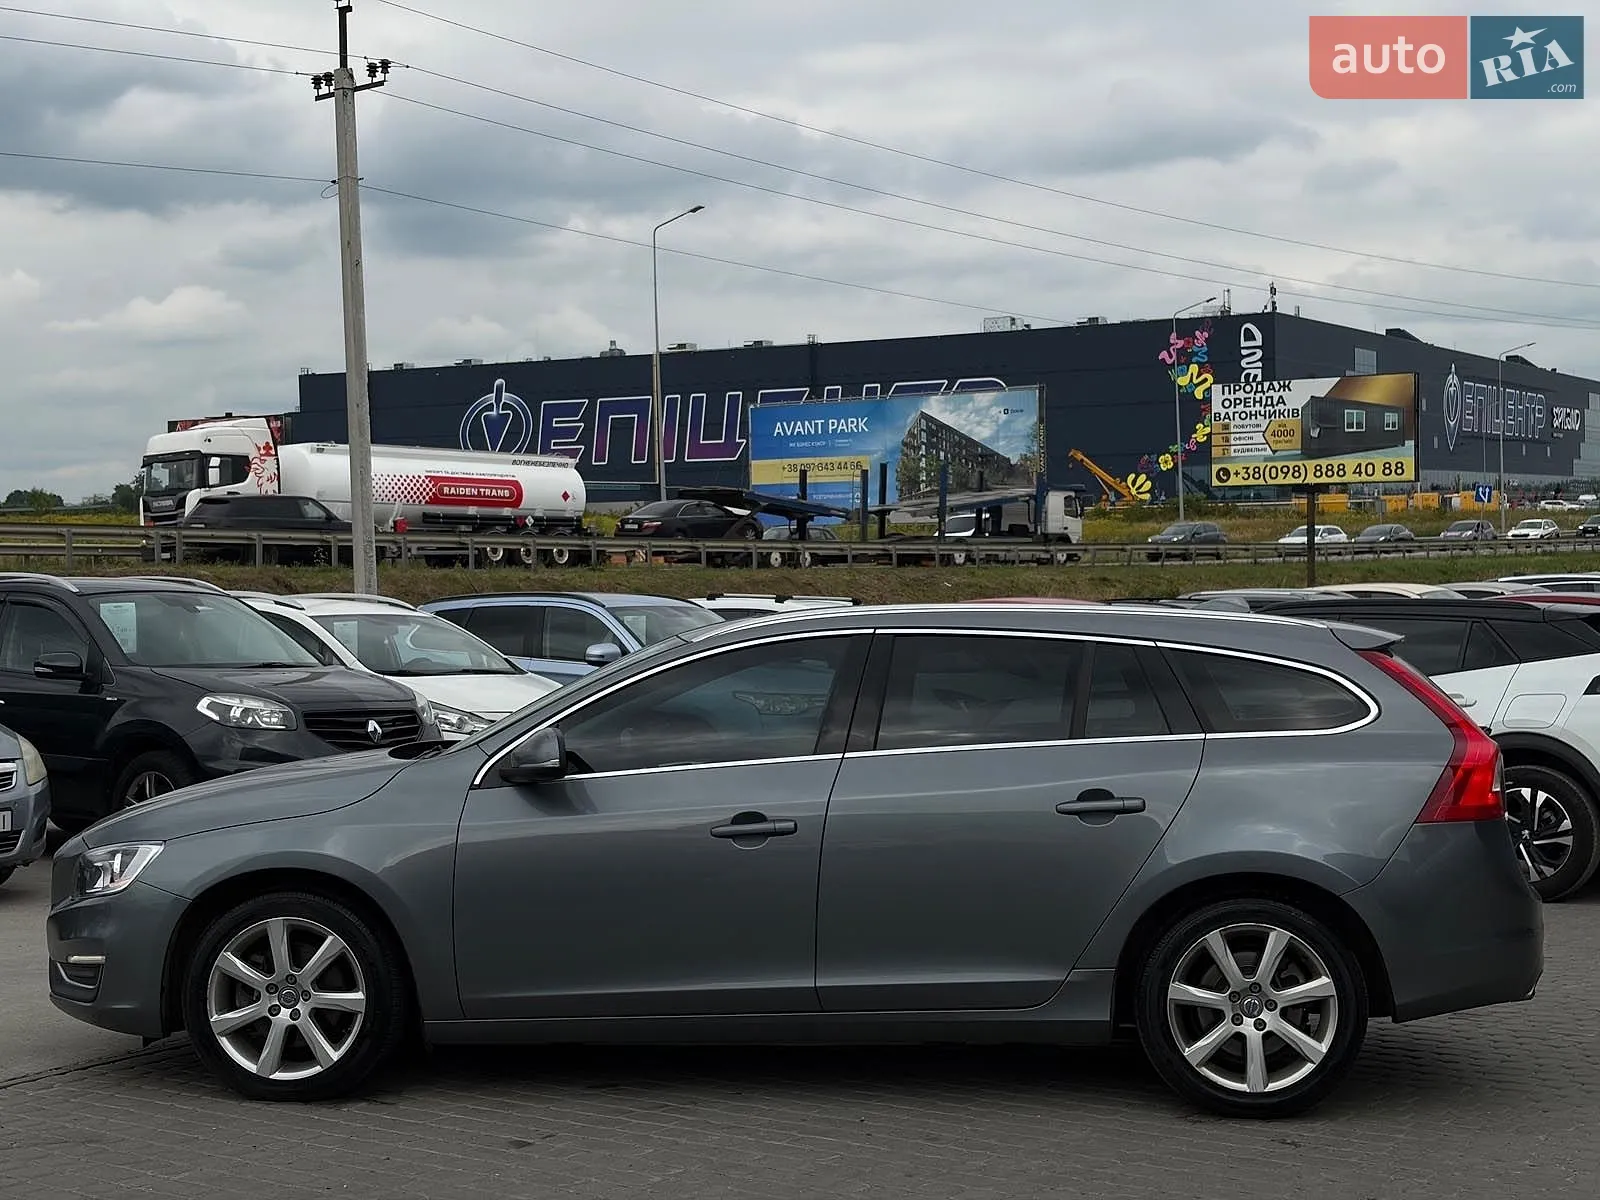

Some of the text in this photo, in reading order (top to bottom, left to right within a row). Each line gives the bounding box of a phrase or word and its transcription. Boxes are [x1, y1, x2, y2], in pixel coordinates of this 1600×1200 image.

[1221, 381, 1292, 396] ПРОДАЖ
[1221, 395, 1287, 409] ОРЕНДА
[1213, 408, 1300, 422] ВАГОНЧИКІВ
[773, 417, 869, 437] AVANT PARK
[1270, 428, 1295, 438] 4000
[1233, 461, 1405, 484] +38(098) 888 40 88
[443, 486, 510, 497] RAIDEN TRANS
